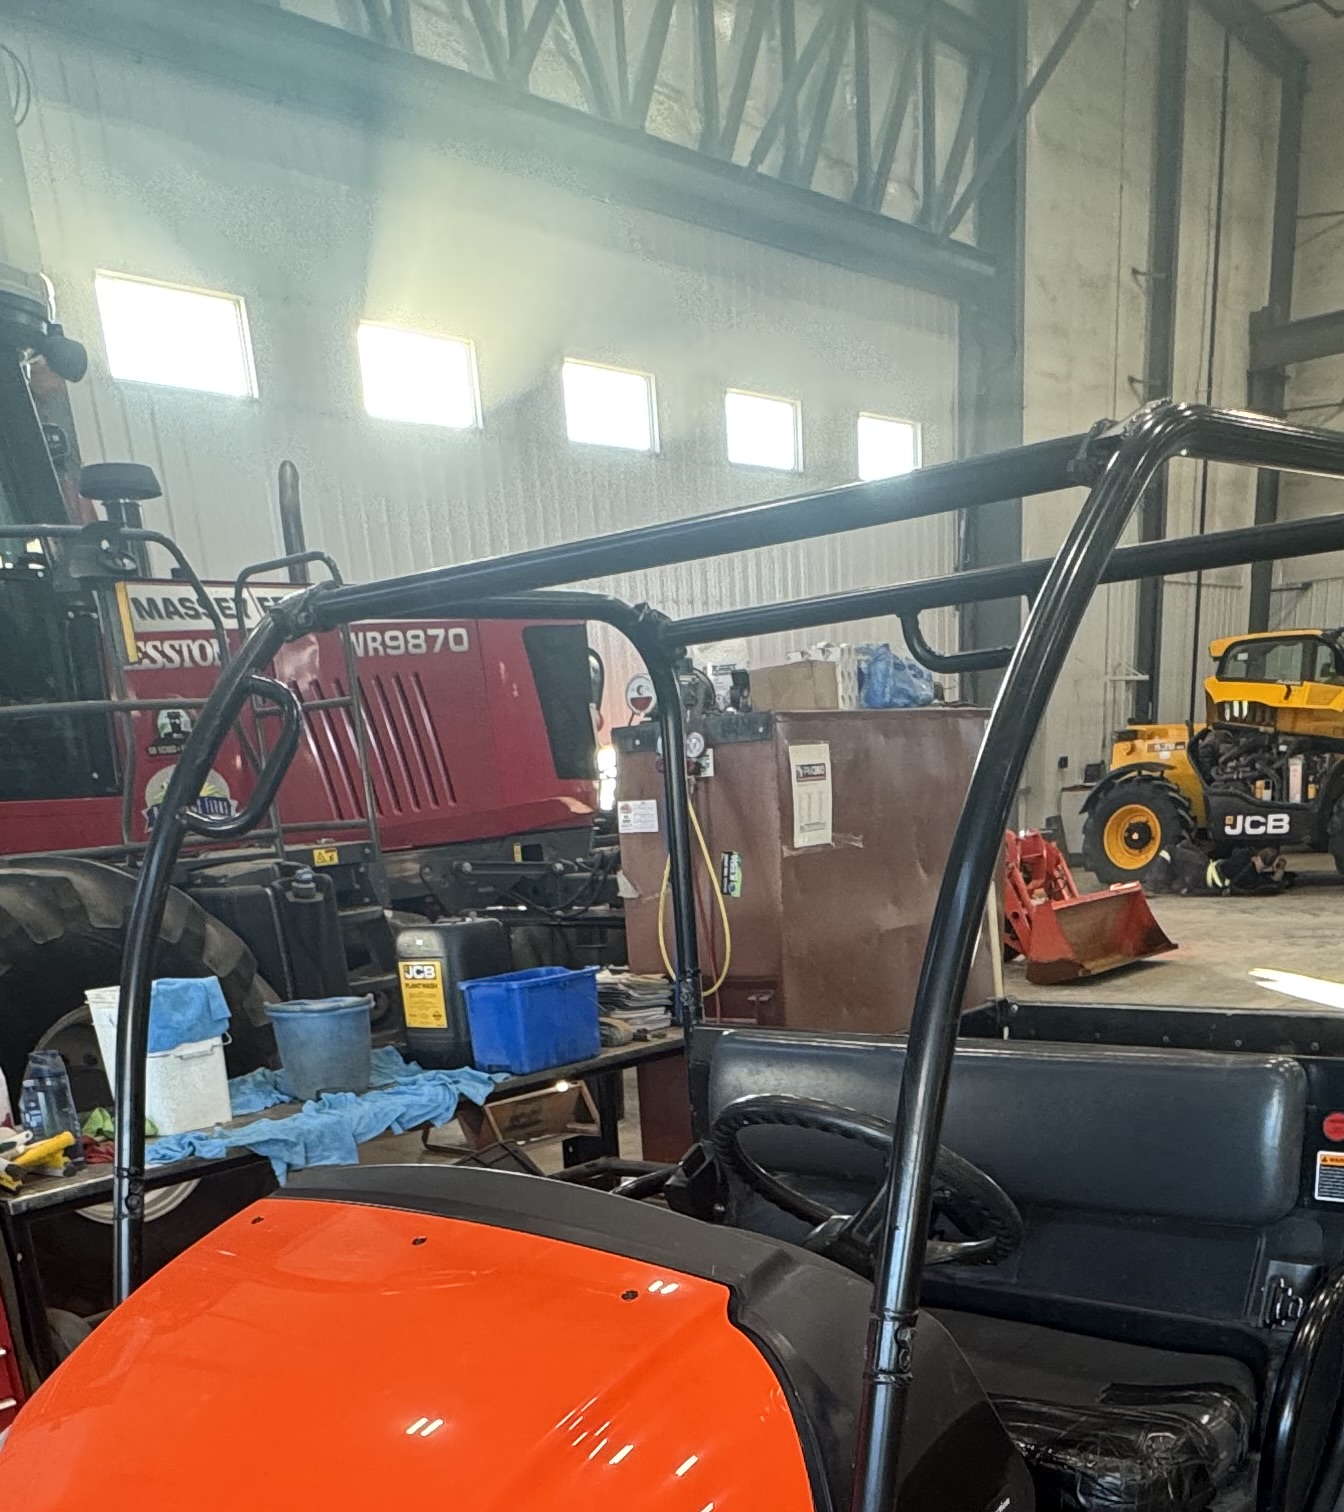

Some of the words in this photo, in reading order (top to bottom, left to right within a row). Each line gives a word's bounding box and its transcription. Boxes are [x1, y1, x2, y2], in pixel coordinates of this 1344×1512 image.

[341, 628, 469, 657] WR9870
[1224, 813, 1290, 835] JCB
[404, 966, 435, 979] JCB
